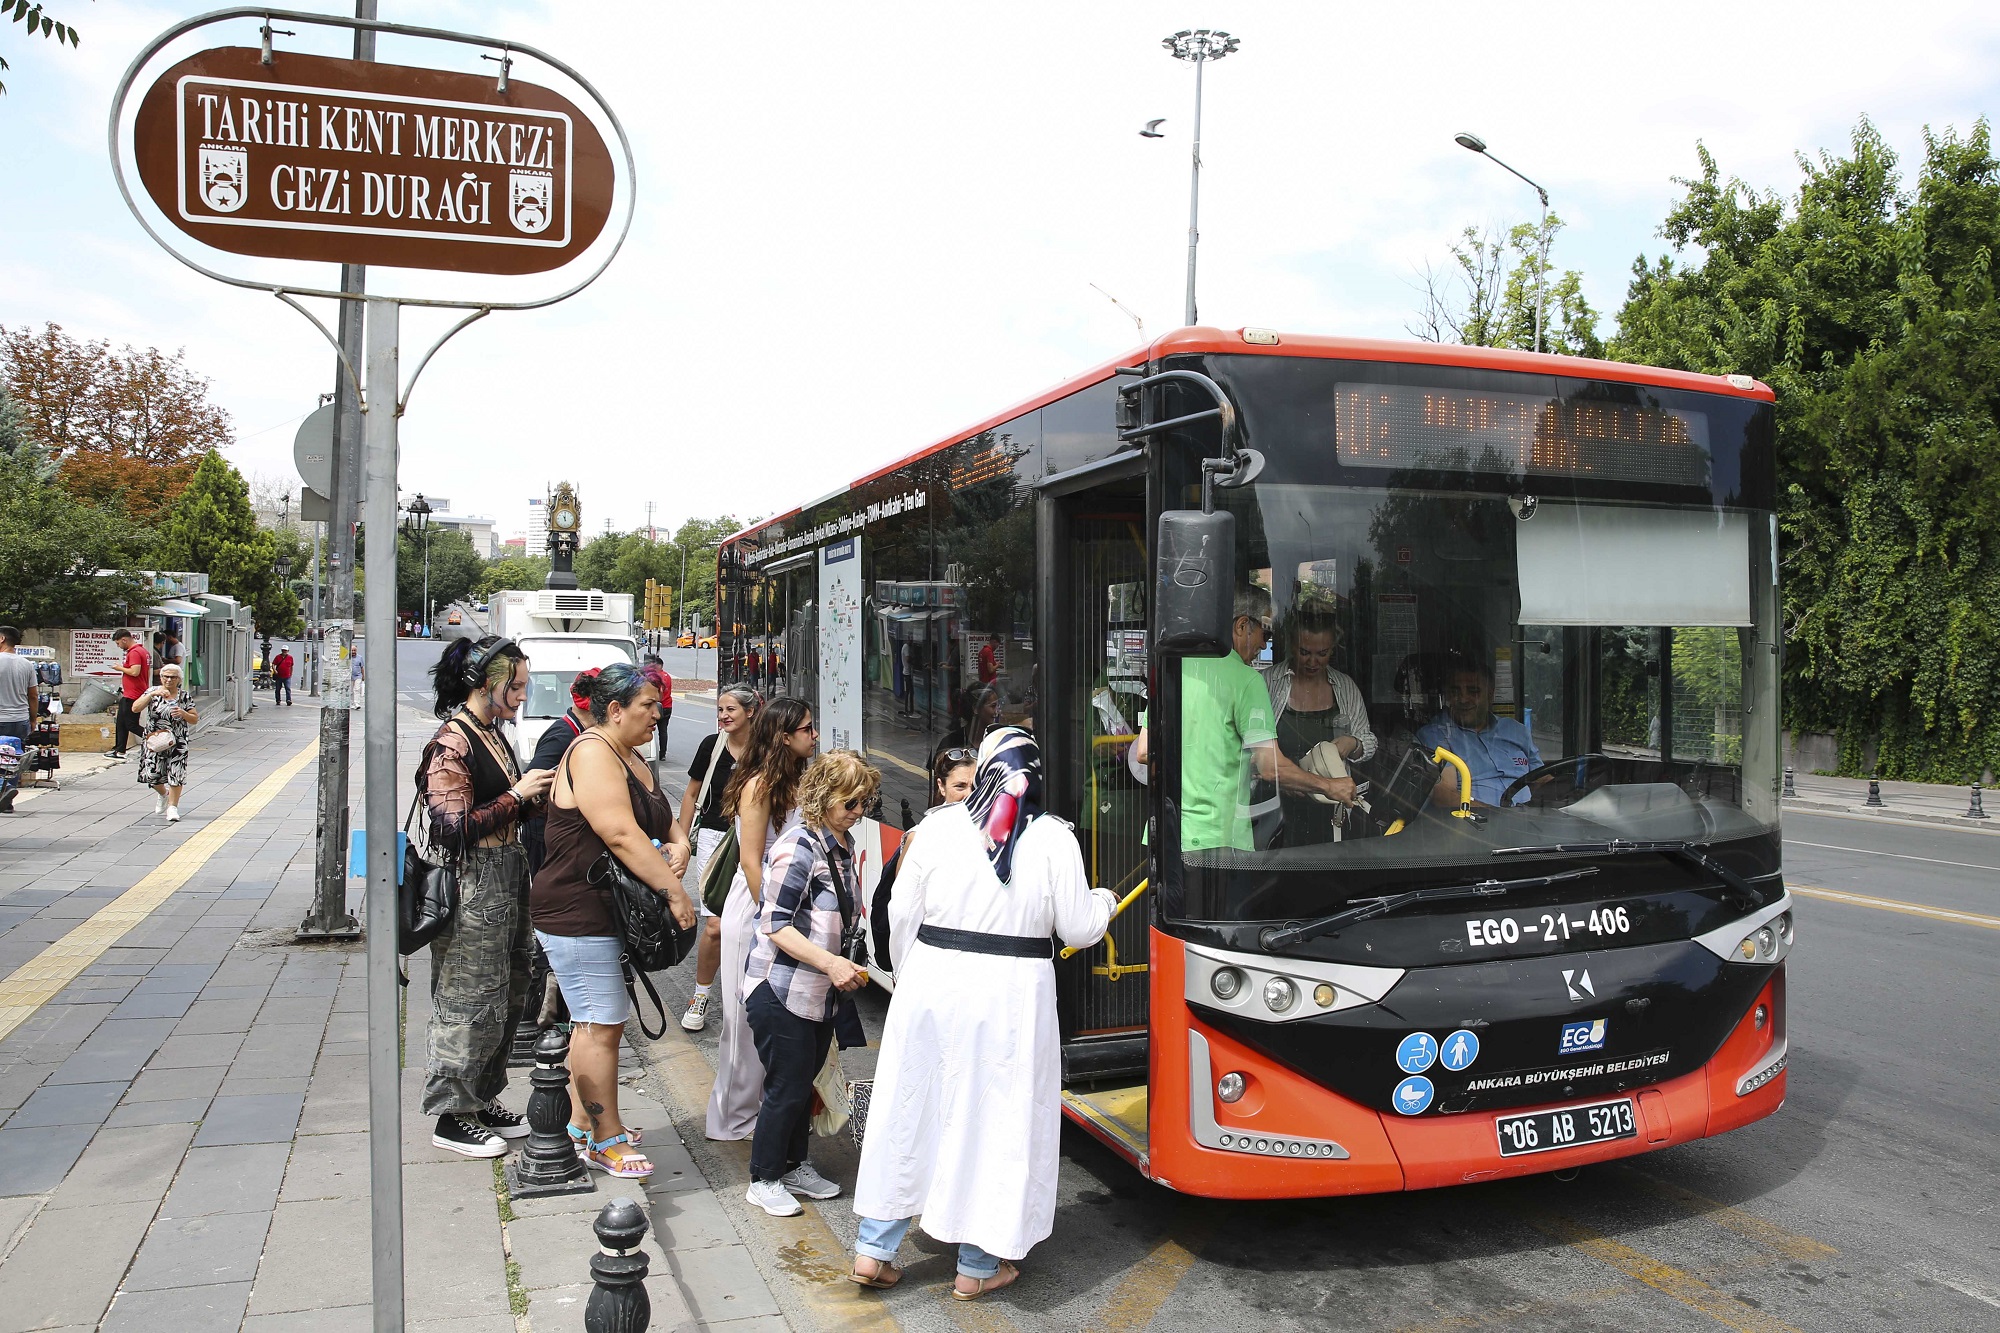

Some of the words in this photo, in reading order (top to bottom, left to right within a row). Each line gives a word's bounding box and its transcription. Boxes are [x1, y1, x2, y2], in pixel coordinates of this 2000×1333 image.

[199, 143, 247, 152] ANKARA
[318, 105, 406, 156] KENT
[510, 168, 553, 177] ANKARA
[361, 171, 492, 225] DURAĞI
[1466, 906, 1630, 946] EGO-21-406
[1562, 1022, 1605, 1047] EGO
[1467, 1075, 1522, 1091] ANKARA
[1525, 1063, 1604, 1084] BÜYÜKŞEHİR
[1606, 1051, 1670, 1073] BELEDİYESİ
[1511, 1119, 1539, 1149] 06
[1552, 1113, 1576, 1143] AB
[1588, 1104, 1633, 1137] 5213
